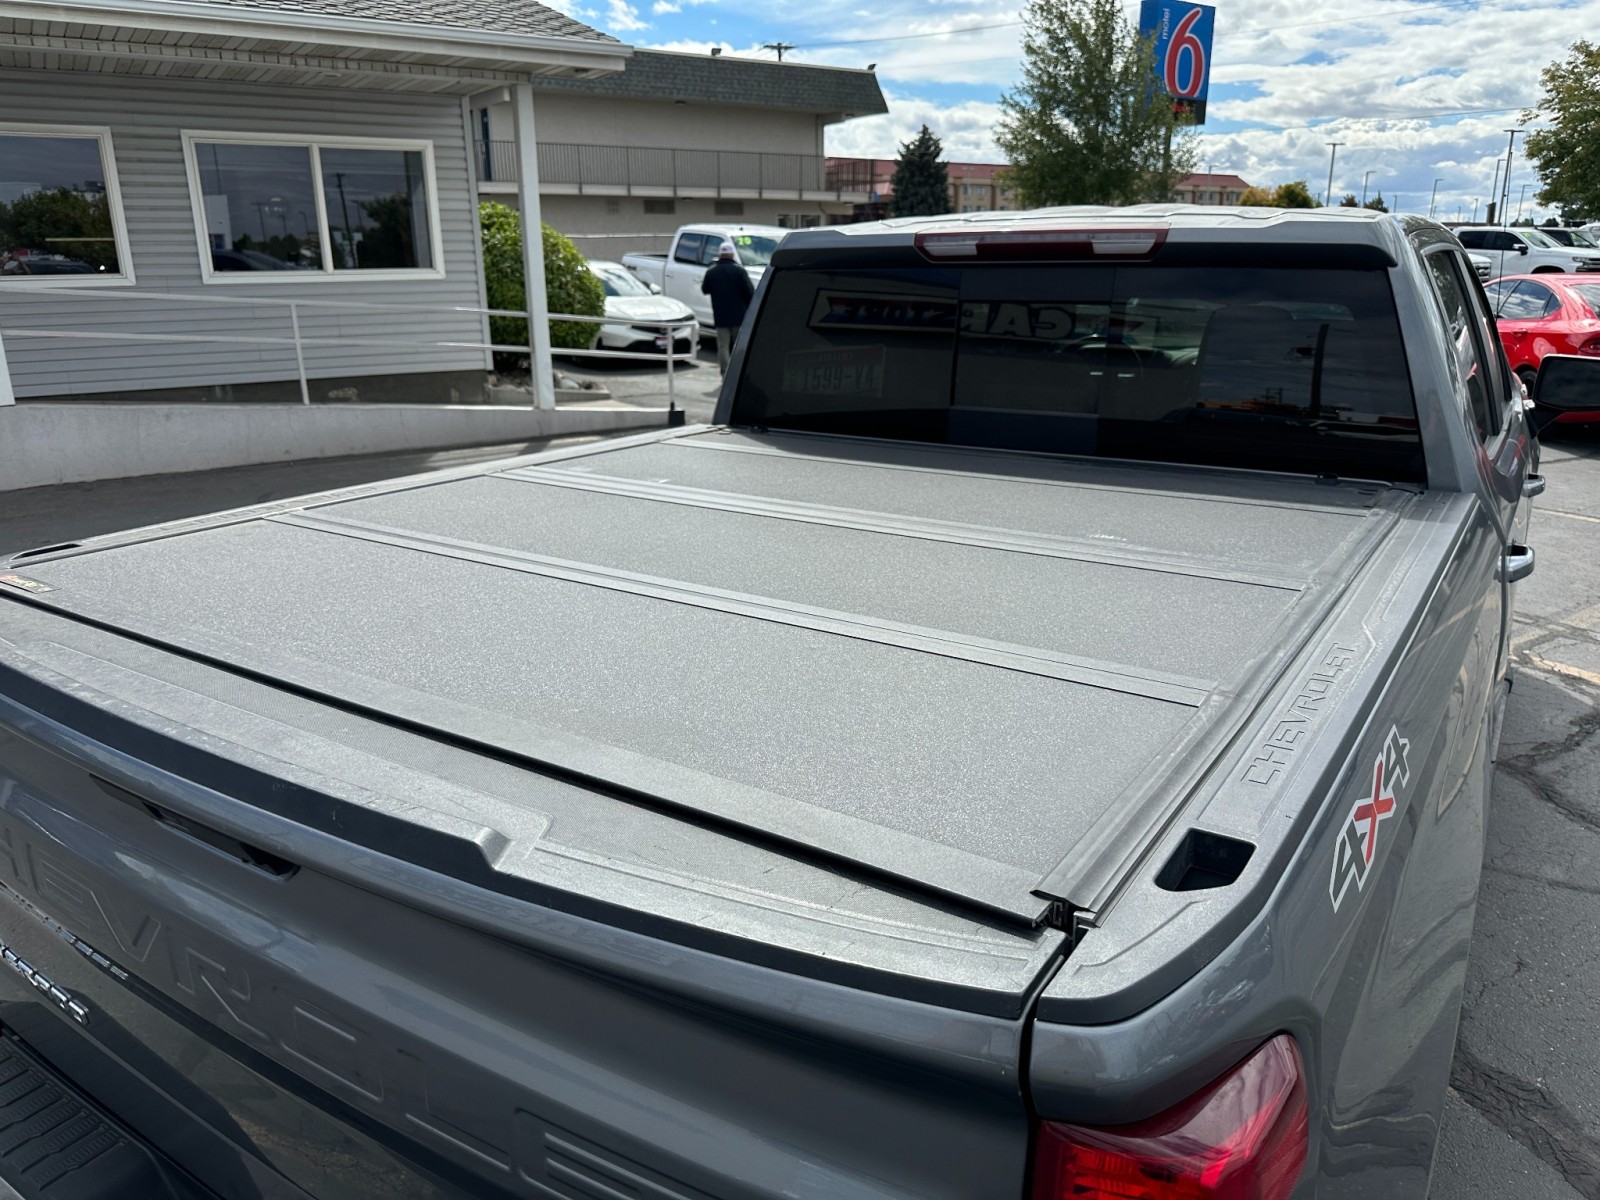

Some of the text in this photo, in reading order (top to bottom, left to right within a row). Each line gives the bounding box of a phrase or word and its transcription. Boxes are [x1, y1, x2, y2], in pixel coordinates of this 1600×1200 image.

[1162, 8, 1171, 39] motel
[1163, 7, 1206, 97] 6
[1241, 643, 1355, 786] CHEVROLET
